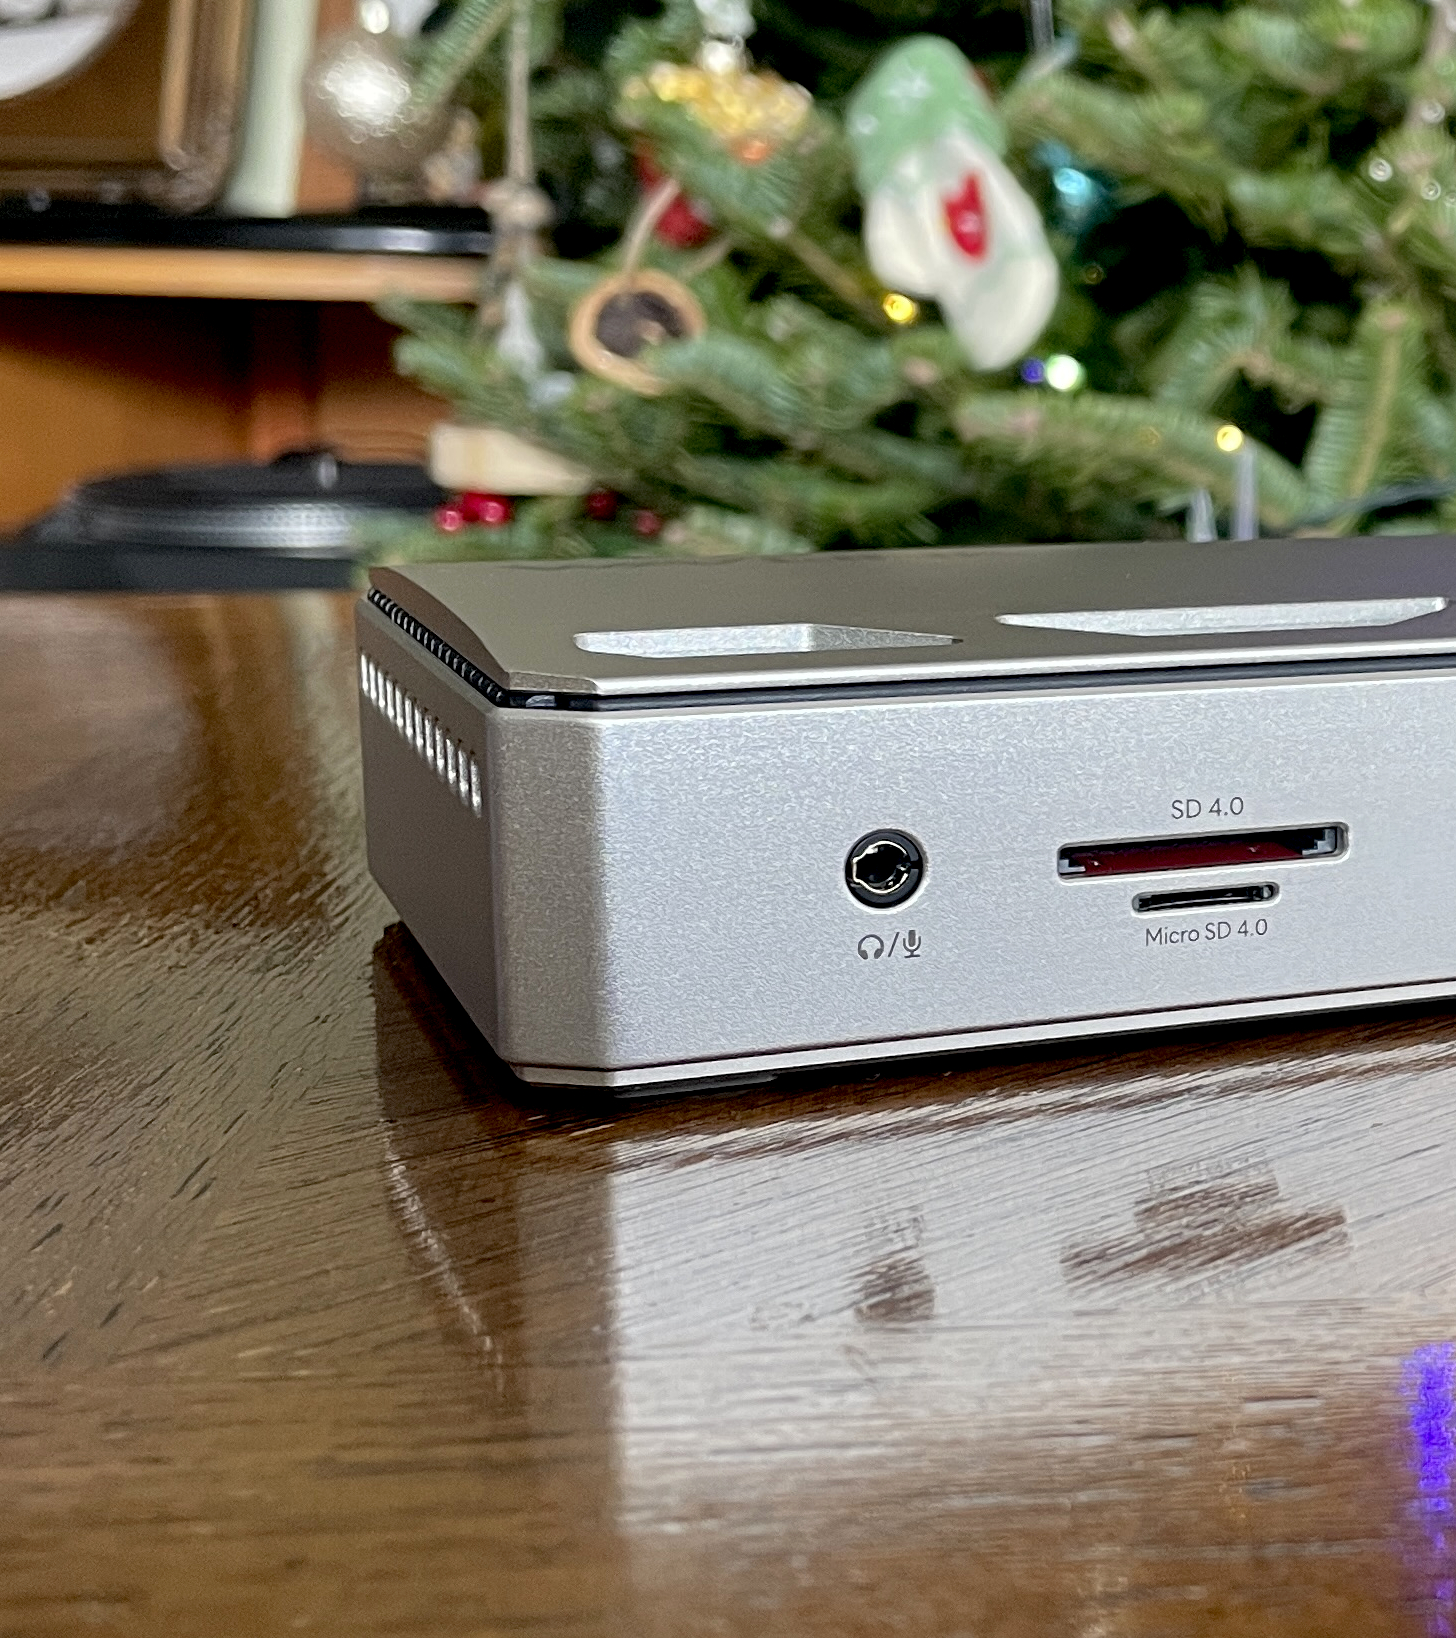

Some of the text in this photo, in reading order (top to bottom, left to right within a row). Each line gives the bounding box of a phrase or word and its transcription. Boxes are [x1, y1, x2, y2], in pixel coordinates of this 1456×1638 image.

[1171, 796, 1244, 820] SD 4.0
[1145, 918, 1269, 947] Micro SD 4.0
